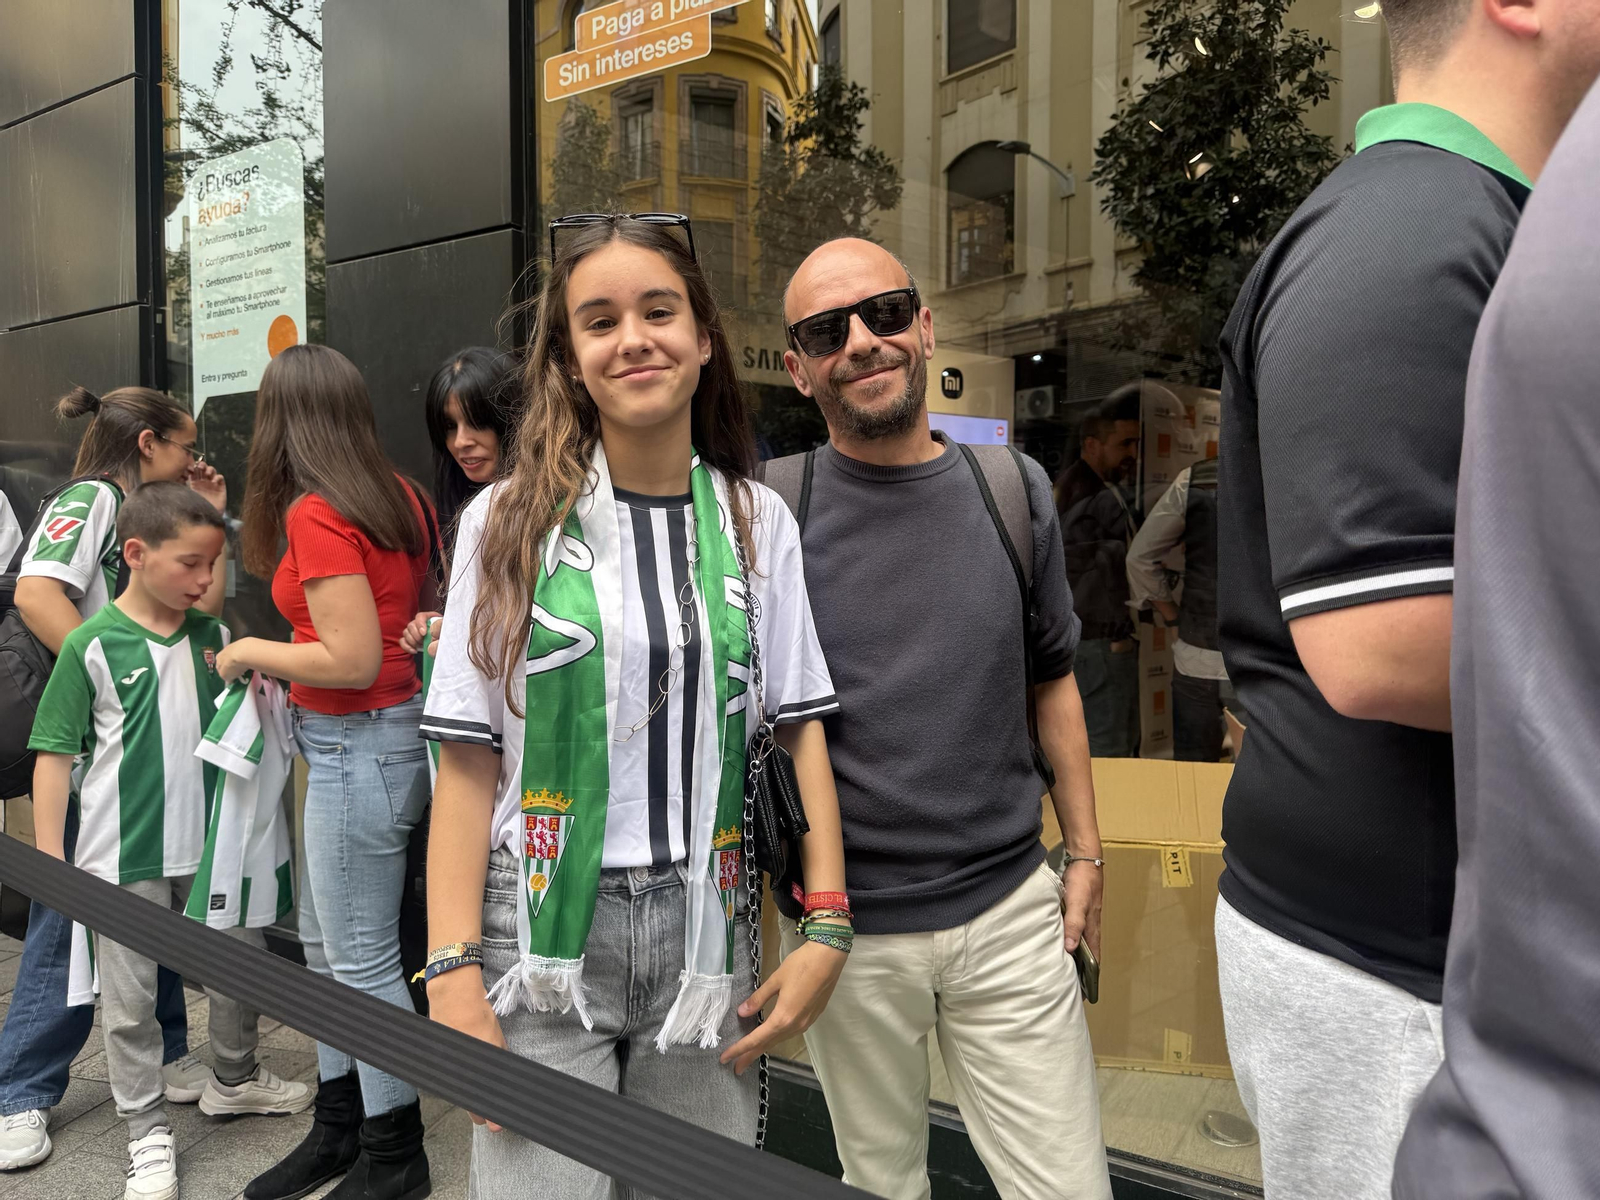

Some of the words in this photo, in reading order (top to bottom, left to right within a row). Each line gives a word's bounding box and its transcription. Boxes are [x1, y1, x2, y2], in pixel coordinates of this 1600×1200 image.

[591, 7, 645, 40] Paga
[650, 2, 664, 21] a
[558, 60, 590, 87] Sin
[595, 31, 694, 77] intereses
[197, 164, 260, 202] ¿Buscas
[198, 190, 250, 228] ayuda?
[204, 231, 238, 247] Analizamos
[238, 229, 245, 238] tu
[246, 224, 268, 237] factura
[205, 251, 246, 267] Configuramos
[246, 249, 253, 257] tu
[253, 240, 292, 256] Smartphone
[205, 273, 243, 288] Gestionamos
[244, 270, 254, 279] tus
[206, 300, 213, 309] Te
[253, 285, 288, 301] aprovechar
[206, 310, 212, 320] al
[236, 305, 243, 314] tu
[243, 299, 281, 313] Smartphone
[200, 333, 205, 341] Y
[206, 329, 226, 341] mucho
[201, 373, 217, 383] Entra
[221, 369, 248, 382] pregunta
[1169, 852, 1182, 875] PIT
